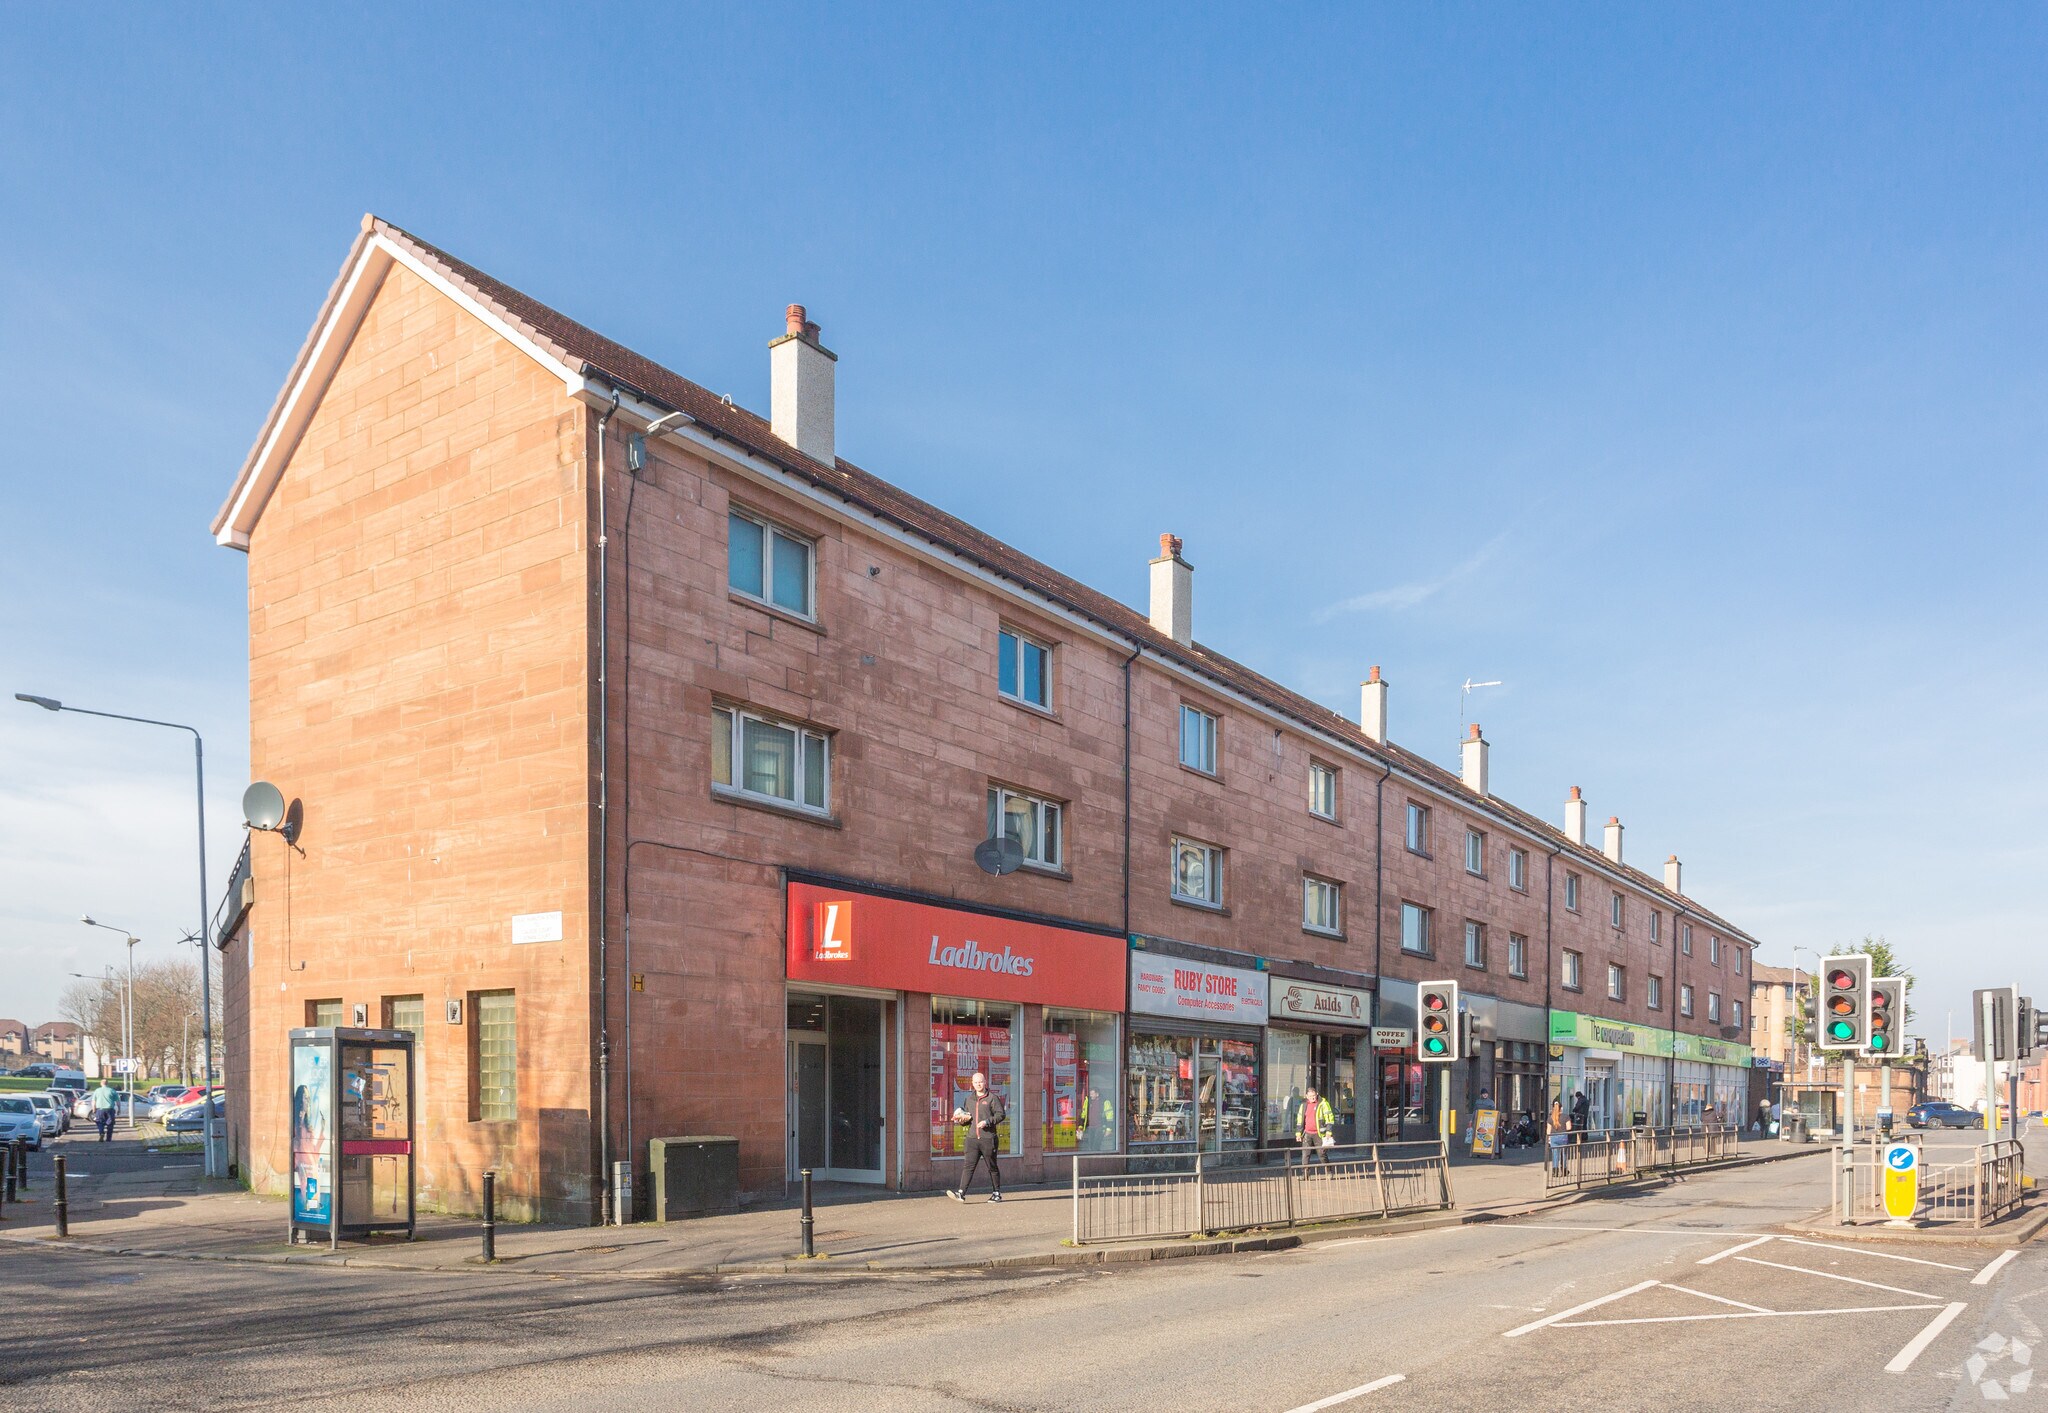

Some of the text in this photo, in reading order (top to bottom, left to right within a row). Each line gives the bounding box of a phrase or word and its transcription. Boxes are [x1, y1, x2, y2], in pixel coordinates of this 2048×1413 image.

[815, 951, 849, 959] Ladbrokes
[928, 935, 1034, 977] Ladbrokes
[1140, 972, 1164, 983] HARDWARE
[1174, 969, 1237, 997] RUBY STORE
[1137, 983, 1166, 994] FANCY GOODS
[1177, 995, 1235, 1011] Computer Accessories
[1314, 994, 1342, 1012] Aulds
[1376, 1030, 1405, 1038] COFFEE
[957, 1033, 979, 1053] BEST
[119, 1060, 128, 1071] P
[957, 1052, 979, 1070] ODDS
